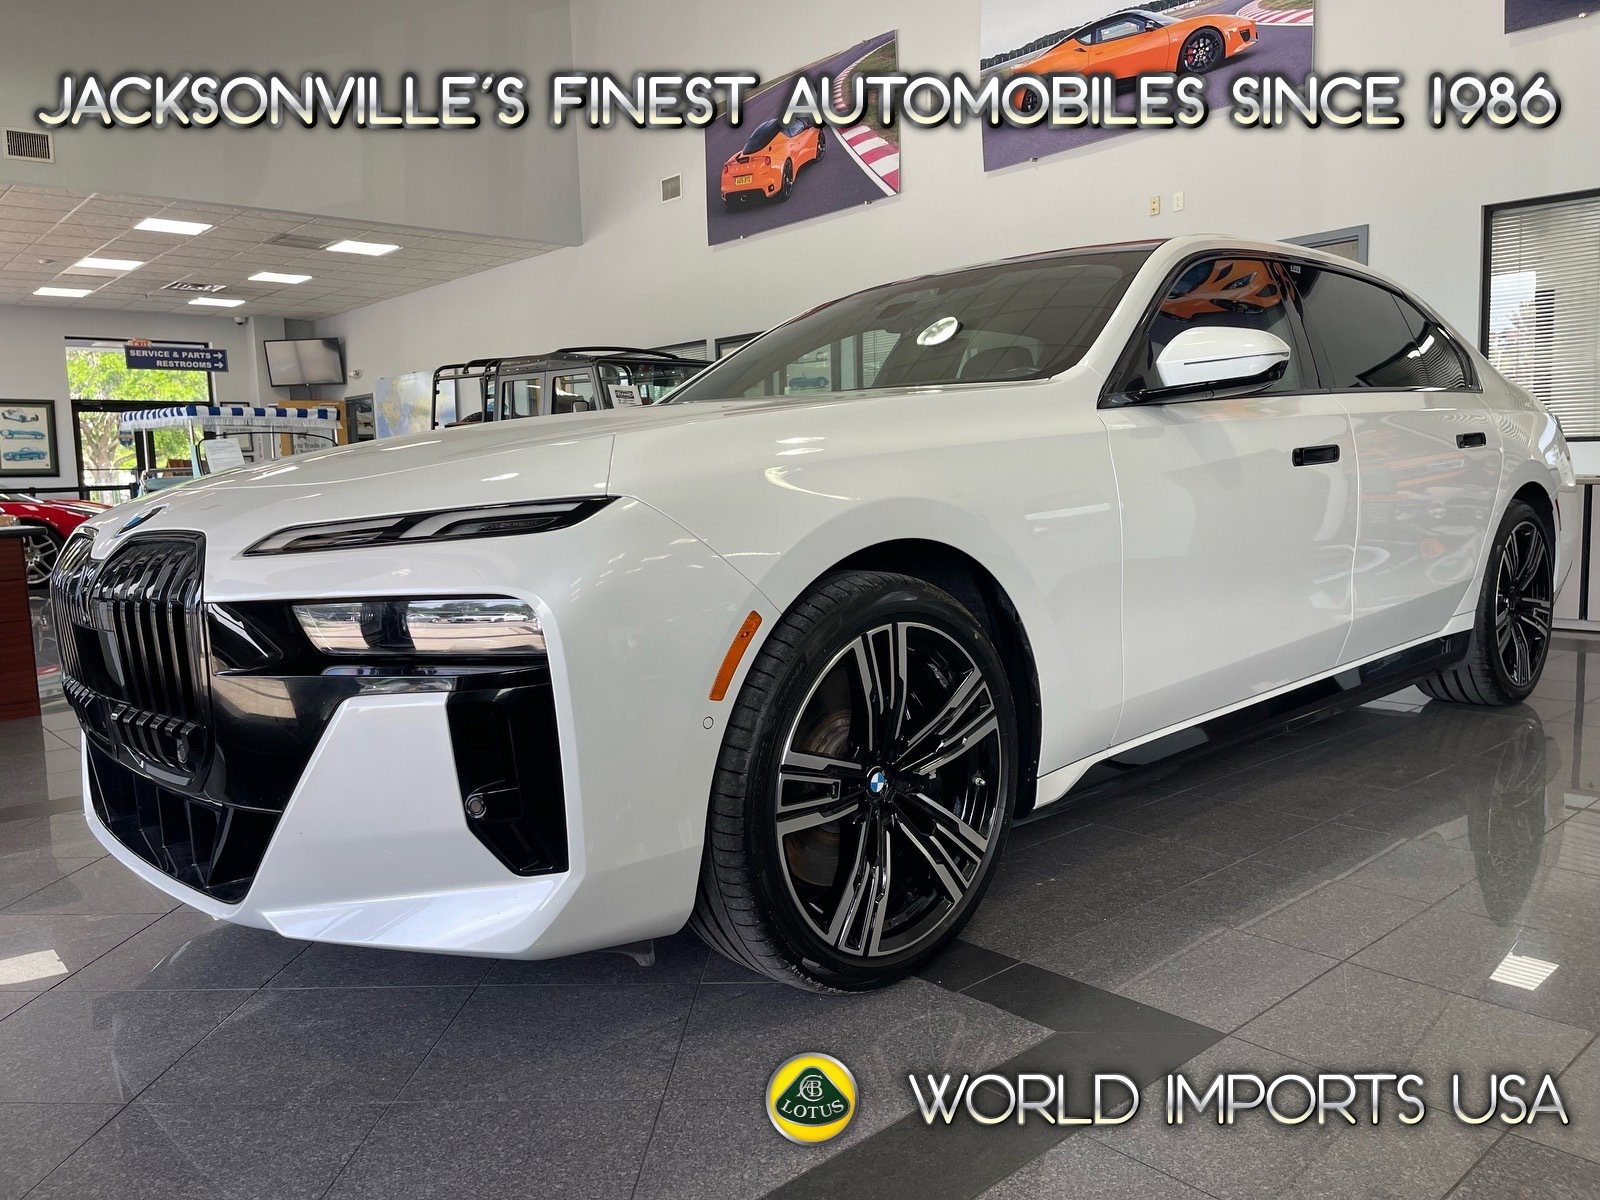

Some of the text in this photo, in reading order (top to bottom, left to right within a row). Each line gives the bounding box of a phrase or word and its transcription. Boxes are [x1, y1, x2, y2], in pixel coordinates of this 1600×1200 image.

[129, 349, 170, 358] SERVICE
[172, 351, 179, 359] &
[156, 360, 212, 368] RESTROOMS
